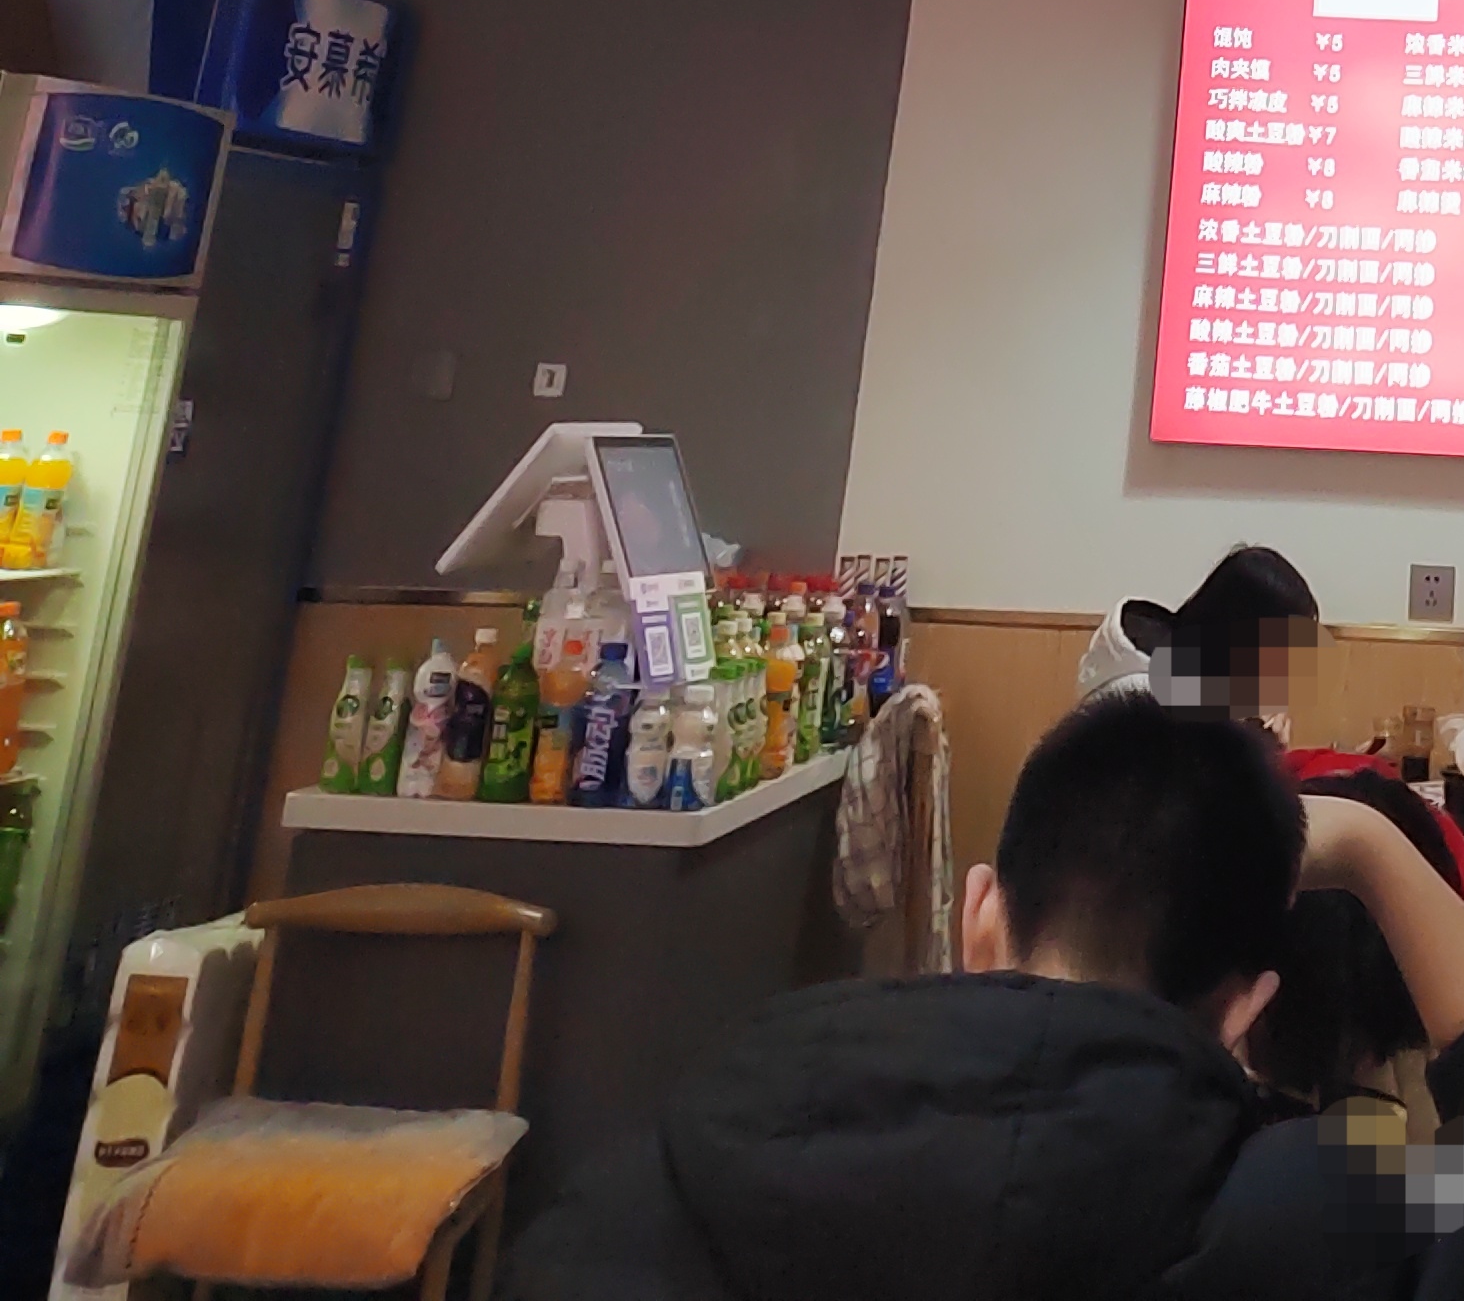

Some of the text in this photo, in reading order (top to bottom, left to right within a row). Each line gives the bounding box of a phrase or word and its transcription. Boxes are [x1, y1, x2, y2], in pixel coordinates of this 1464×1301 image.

[1213, 26, 1343, 52] 馄饨 ¥5
[281, 22, 381, 105] 安慕希
[1211, 57, 1271, 81] 肉夹馍
[1205, 119, 1337, 146] 酸爽土豆粉 ¥7
[1203, 150, 1264, 176] 酸辣粉
[1201, 182, 1262, 208] 麻辣粉
